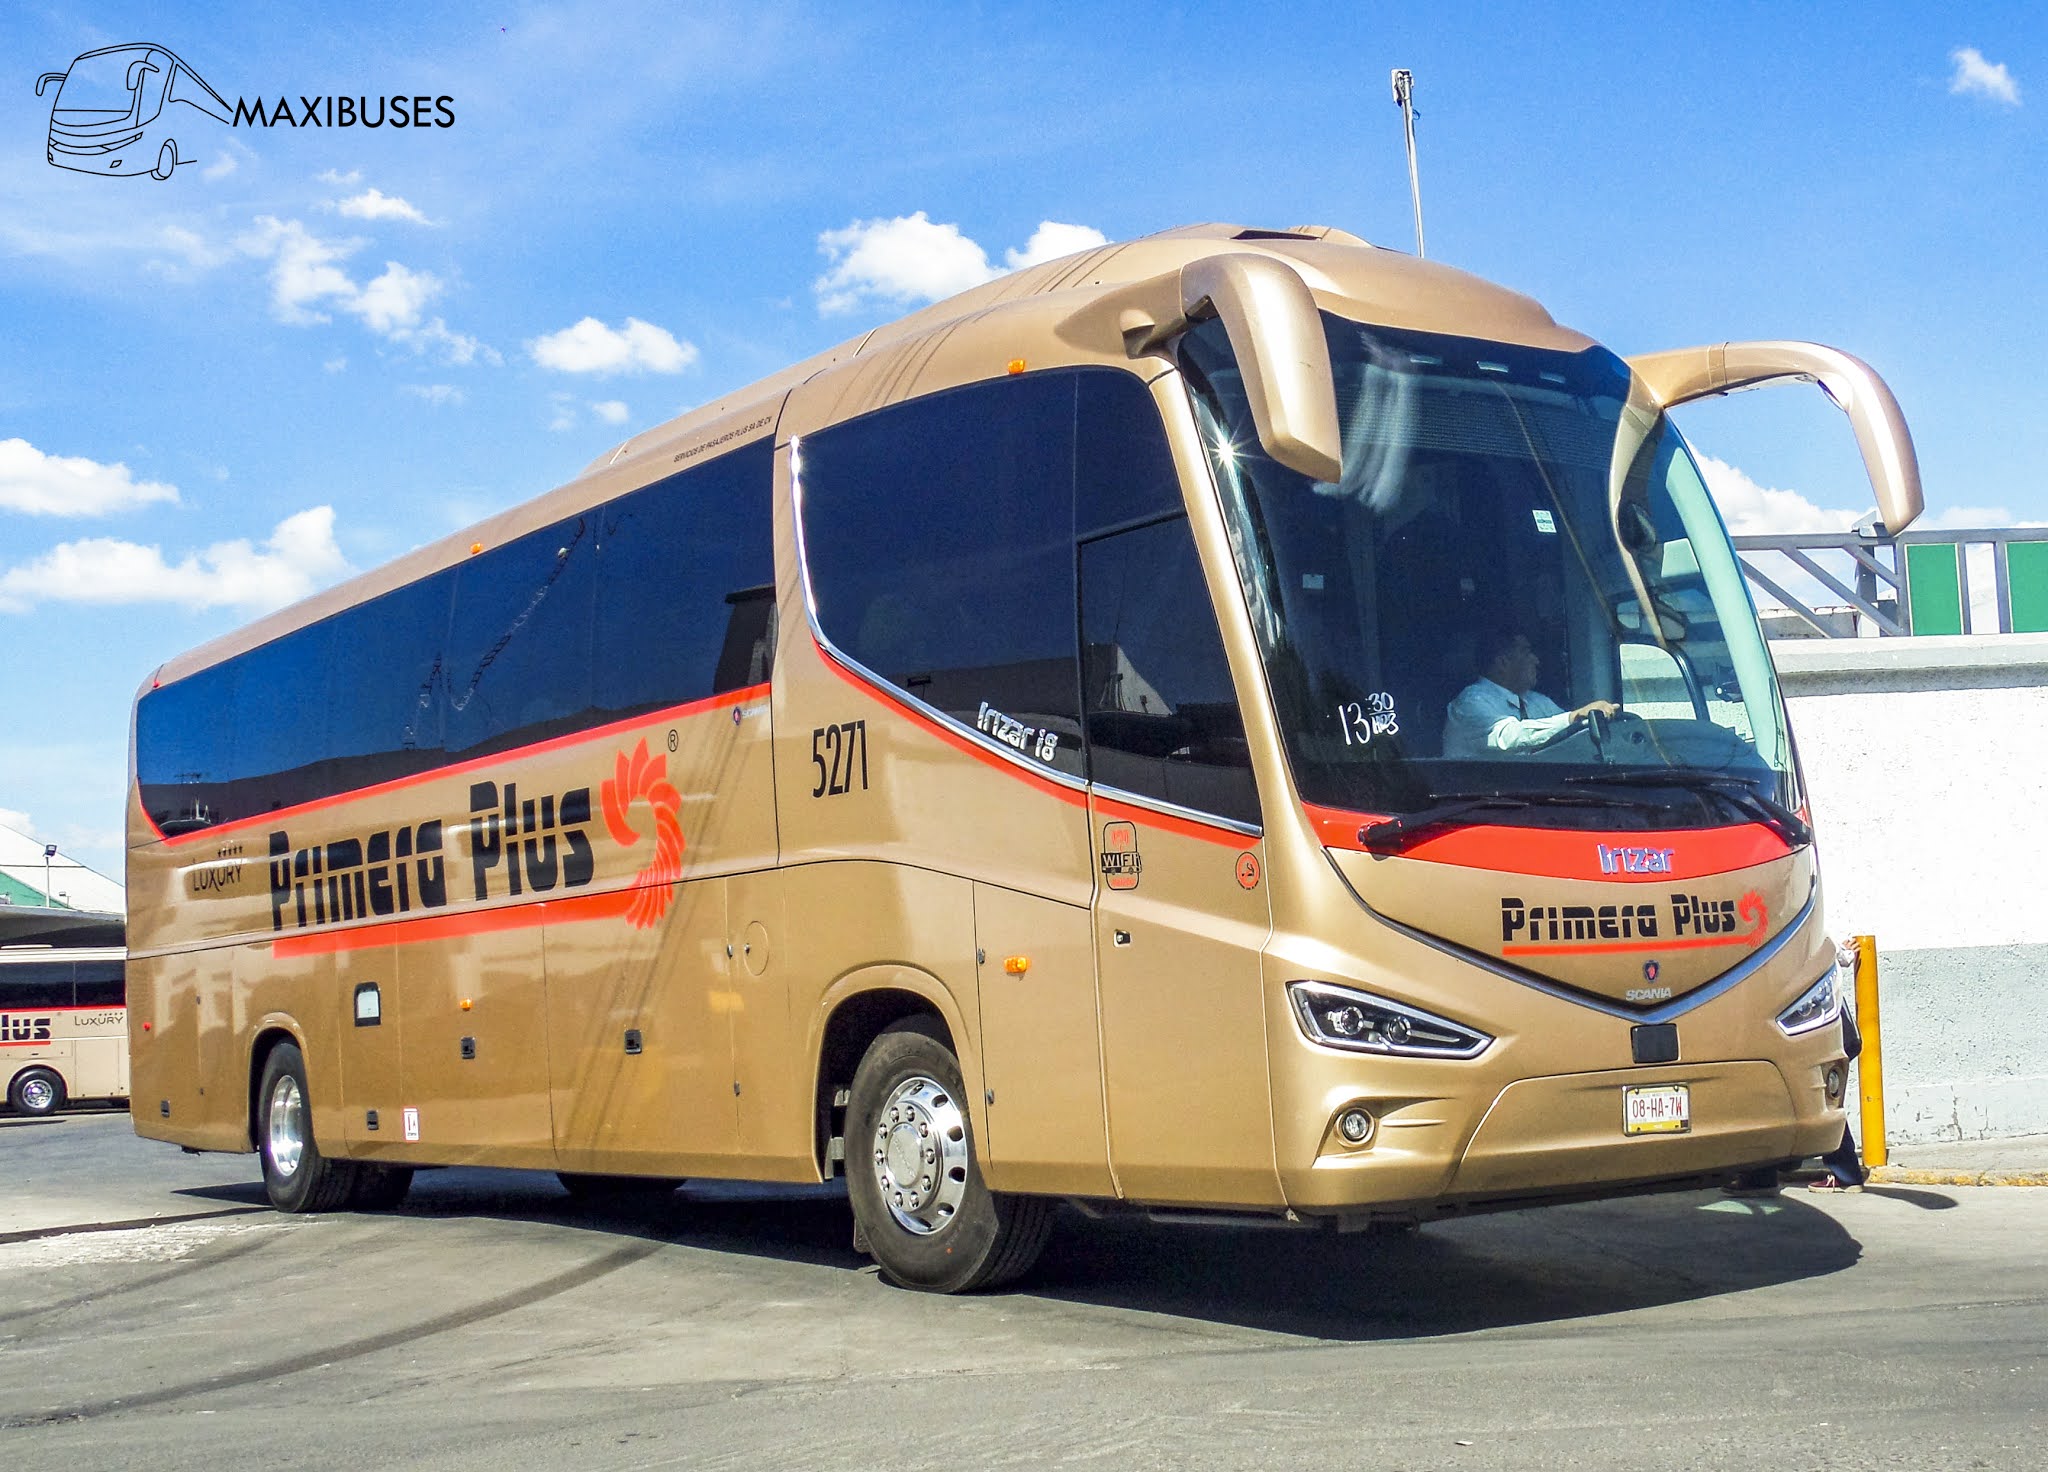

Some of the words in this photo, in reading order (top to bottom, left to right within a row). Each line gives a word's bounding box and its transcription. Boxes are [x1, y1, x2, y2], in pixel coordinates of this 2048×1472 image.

[977, 701, 1035, 750] Irizar
[1035, 728, 1058, 761] i8
[813, 719, 868, 798] 5271
[269, 819, 447, 931] Primera
[470, 780, 594, 901] Plus
[1103, 854, 1135, 868] WIFI
[1597, 844, 1674, 874] Irizar
[193, 858, 243, 892] LUXURY
[1501, 897, 1658, 941] Primera
[1671, 893, 1736, 936] Plus
[1626, 987, 1672, 1000] SCANIA
[1, 1014, 51, 1041] lus
[74, 1015, 123, 1026] LUXURY
[1632, 1096, 1682, 1118] 08-HA-7W
